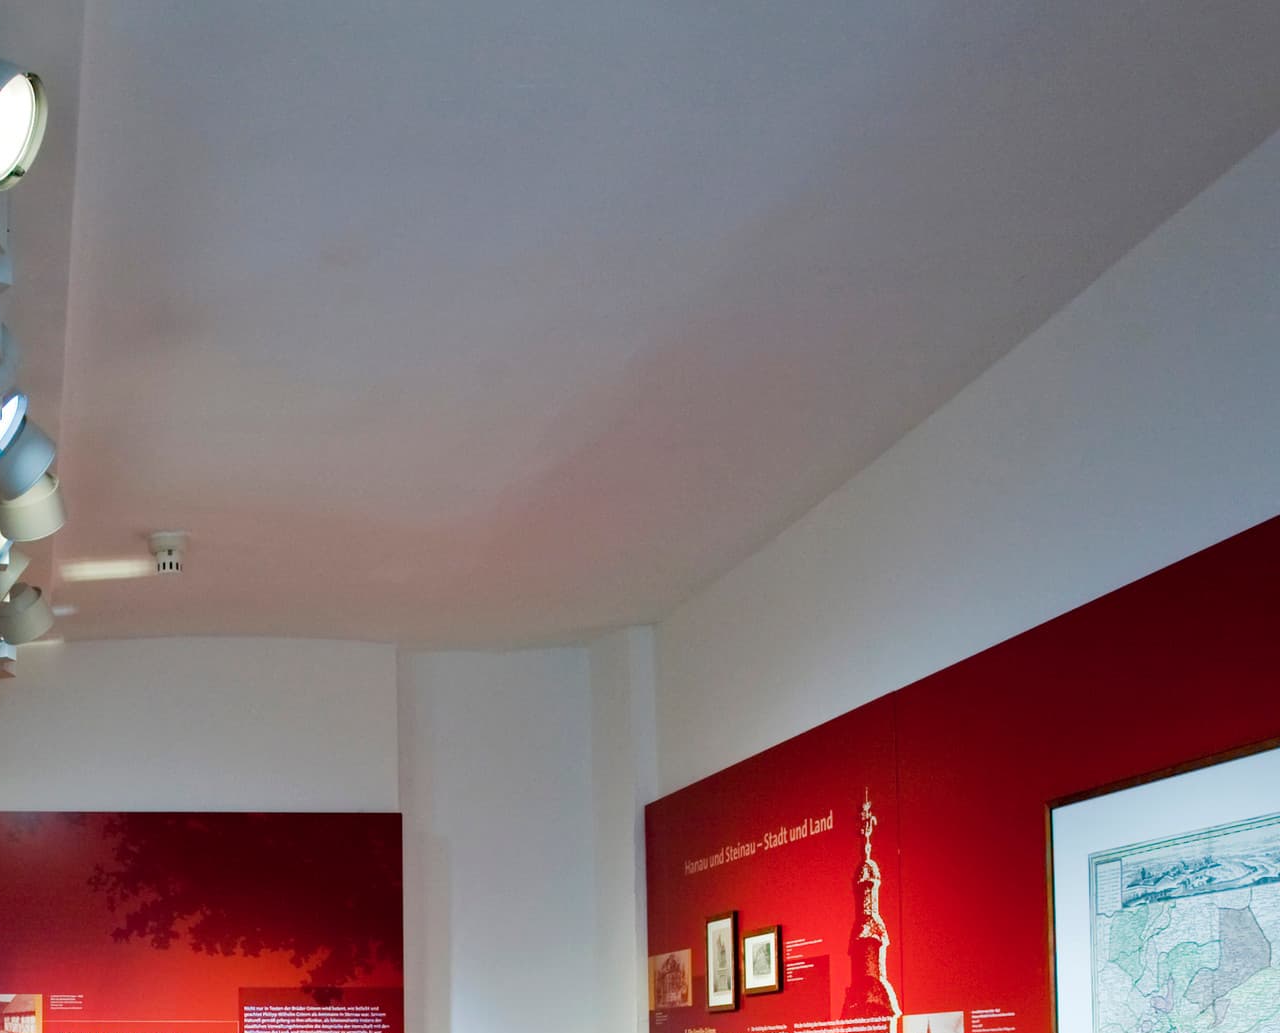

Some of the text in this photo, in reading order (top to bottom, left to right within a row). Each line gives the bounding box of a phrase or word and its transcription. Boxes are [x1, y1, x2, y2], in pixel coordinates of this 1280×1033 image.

[685, 858, 708, 875] Hanau
[709, 848, 724, 867] und
[725, 841, 756, 862] Steinau
[763, 830, 787, 850] Stadt
[790, 819, 808, 841] und
[810, 809, 833, 835] Land
